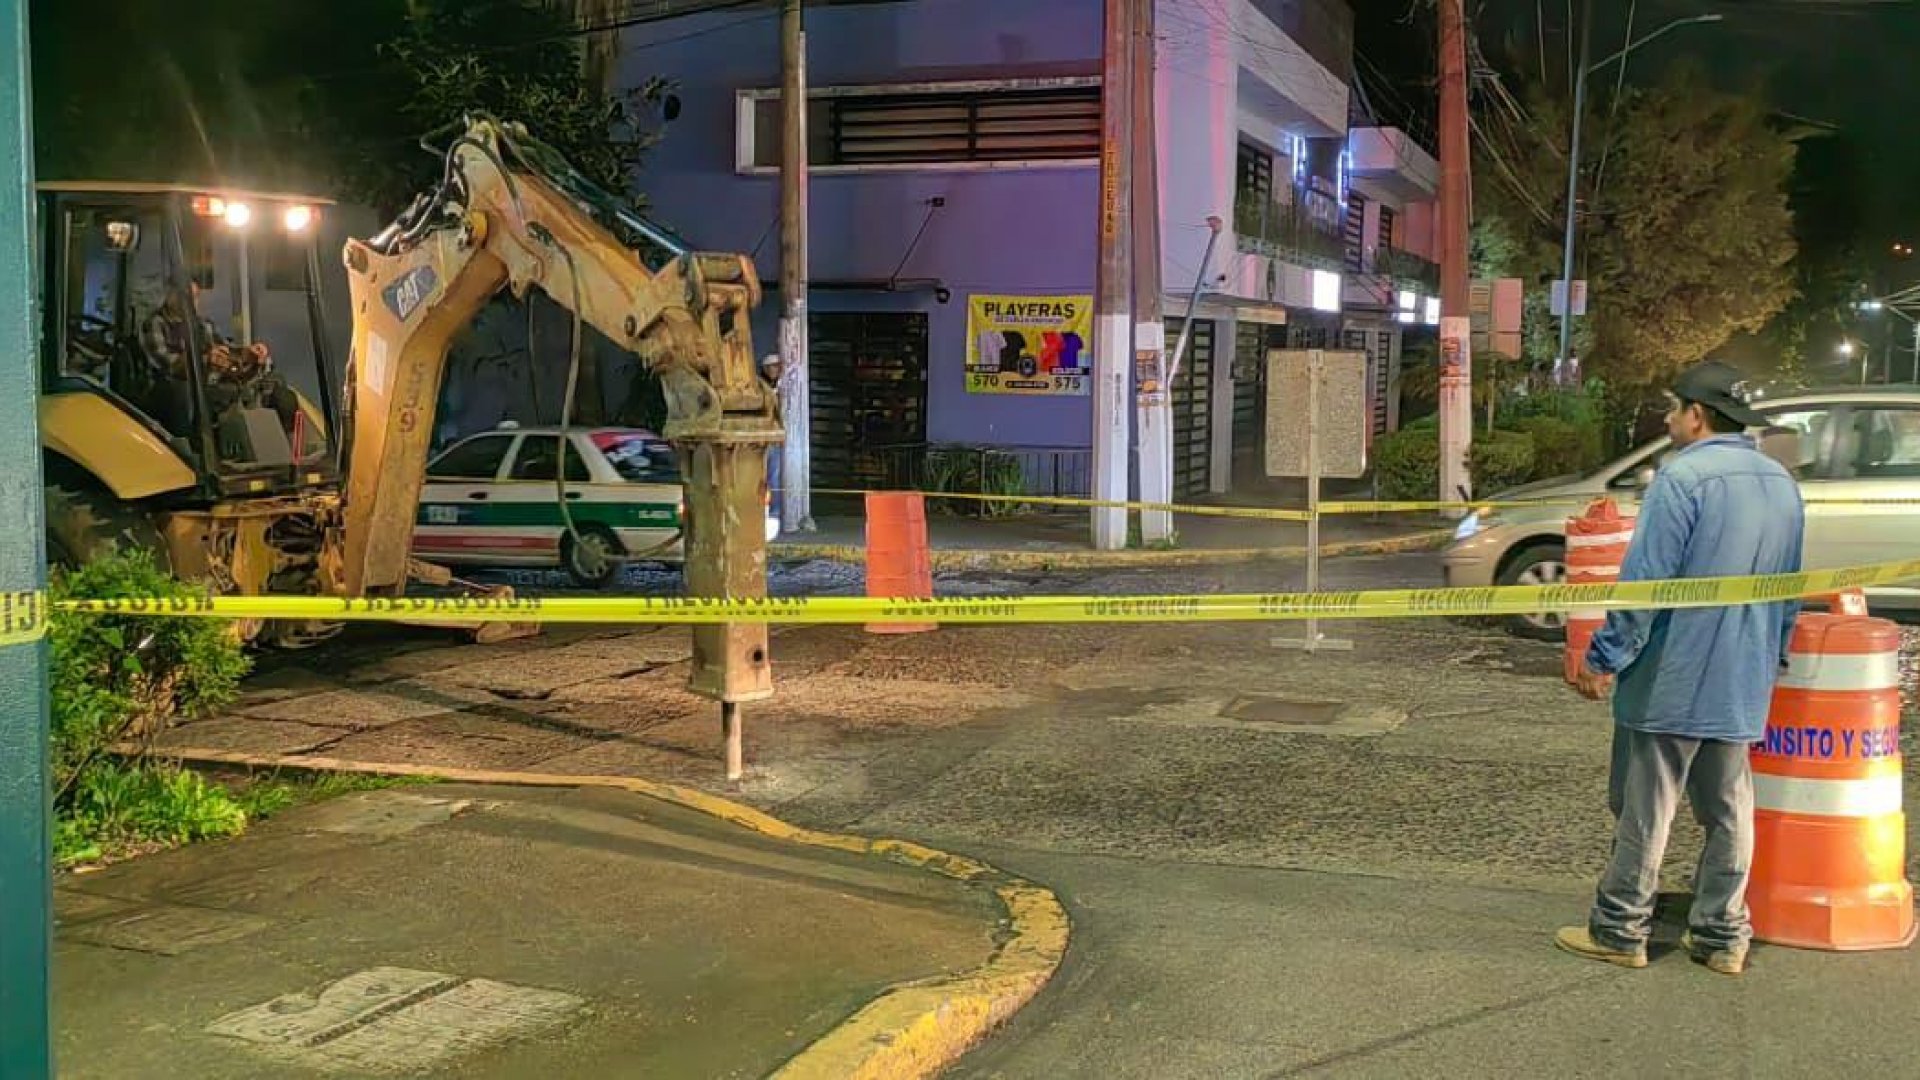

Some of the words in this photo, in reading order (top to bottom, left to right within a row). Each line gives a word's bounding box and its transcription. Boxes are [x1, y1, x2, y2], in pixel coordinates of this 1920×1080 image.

[396, 272, 420, 318] CAT
[984, 302, 1075, 319] PLAYERAS
[1843, 730, 1854, 756] Y
